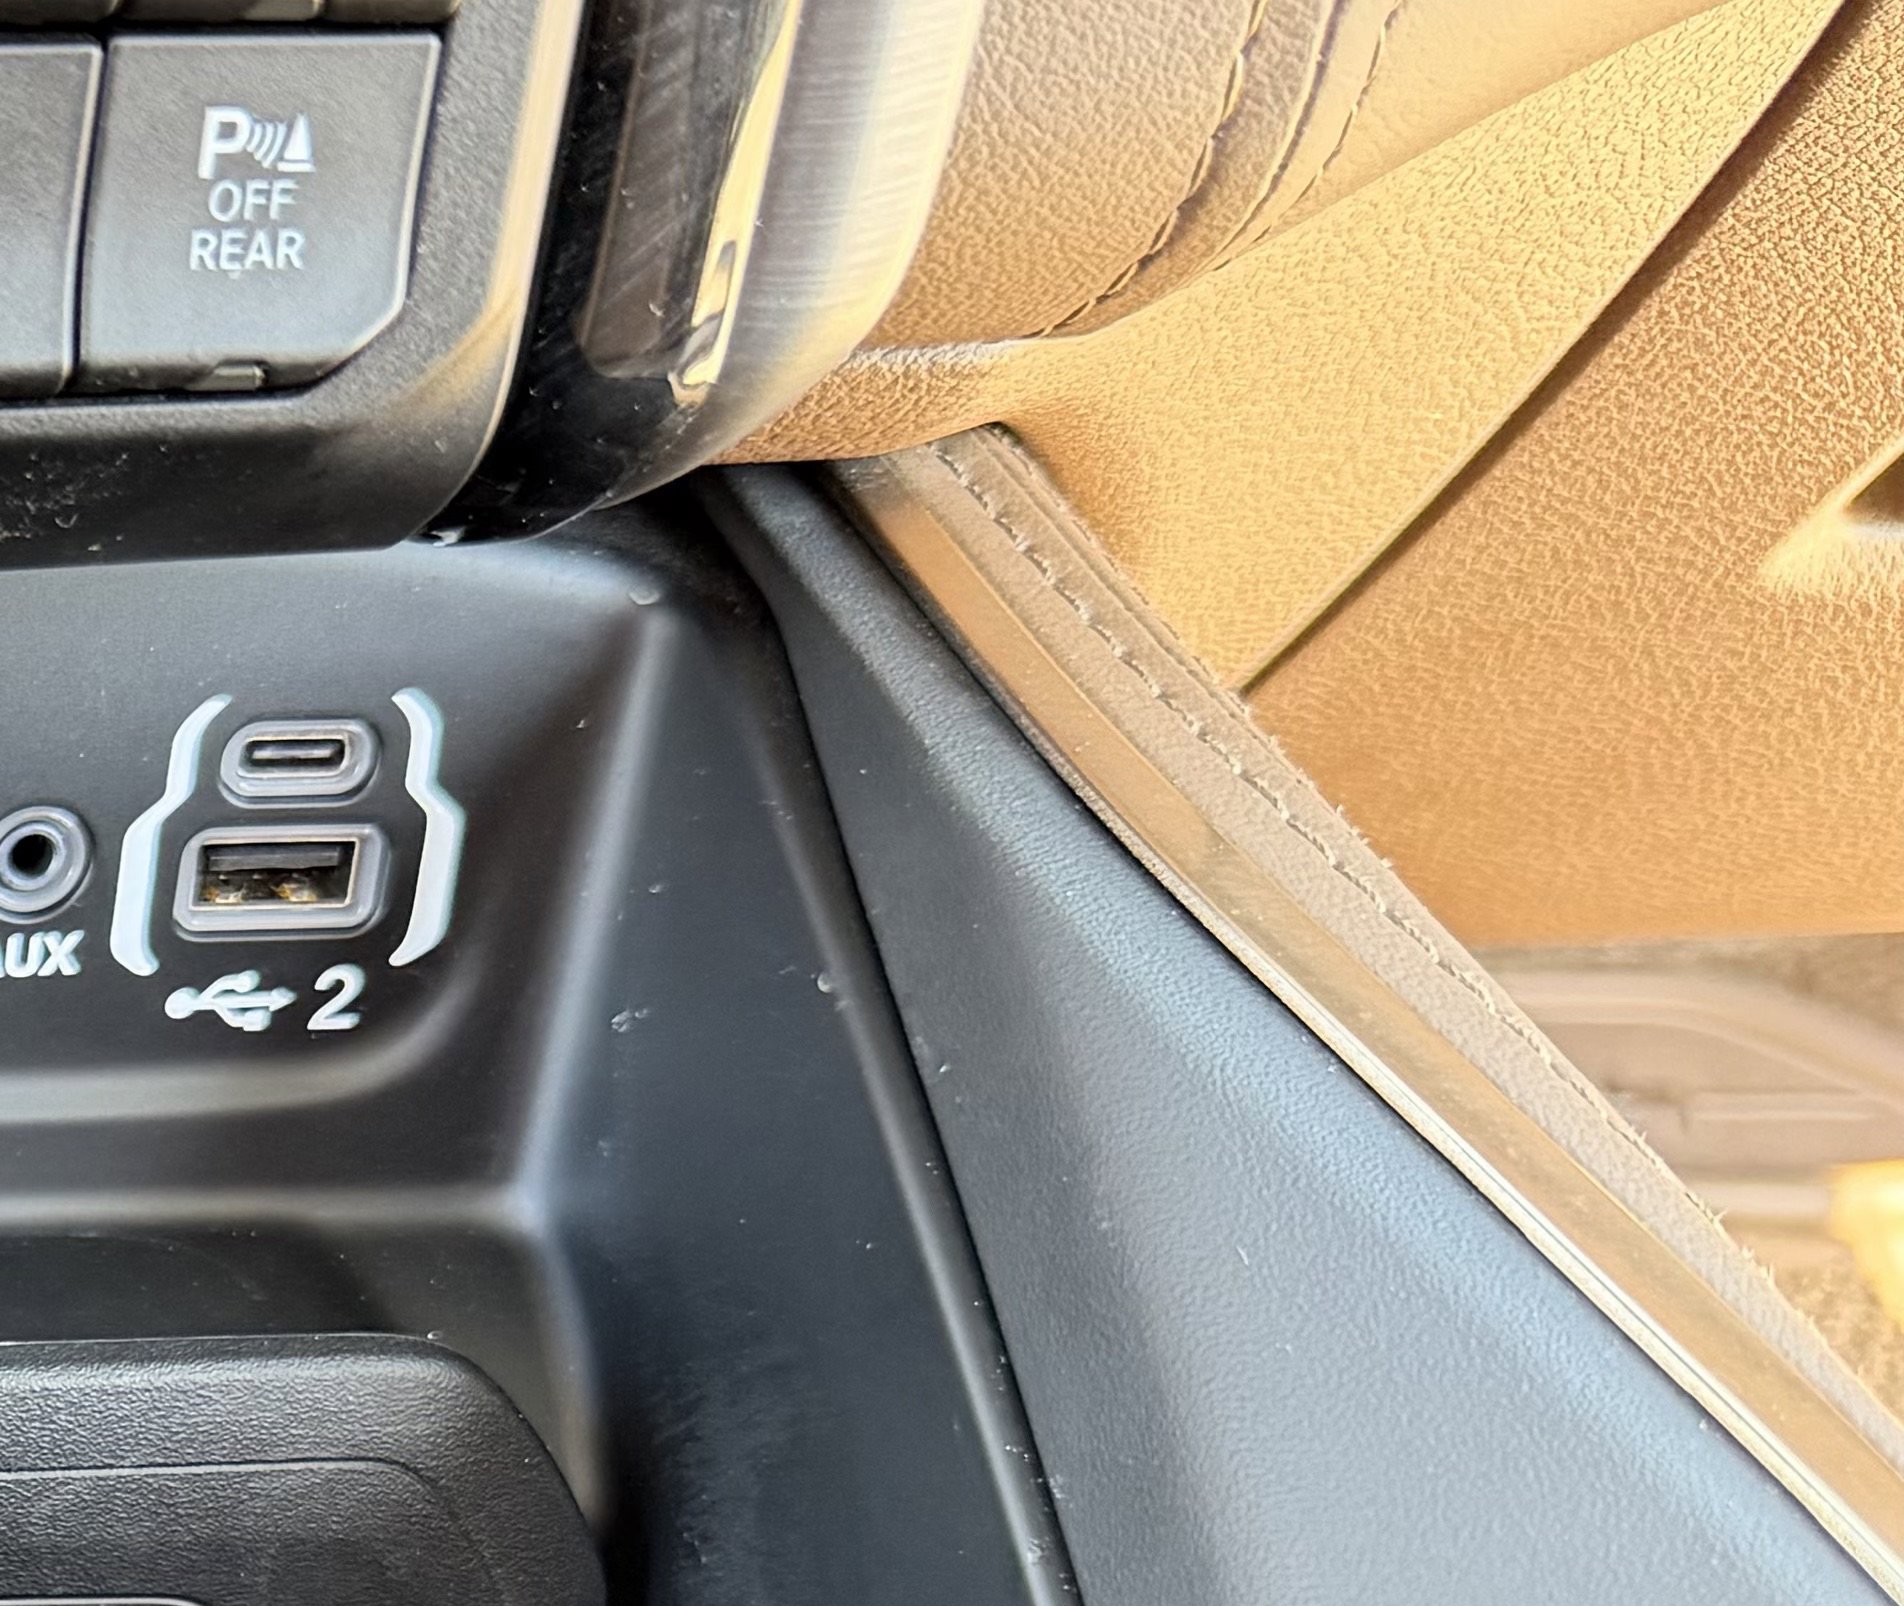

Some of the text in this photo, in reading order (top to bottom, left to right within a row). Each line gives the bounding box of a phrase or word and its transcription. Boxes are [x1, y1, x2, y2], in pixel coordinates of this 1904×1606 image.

[206, 180, 297, 222] OFF
[188, 231, 305, 273] REAR
[306, 964, 368, 1032] 2
